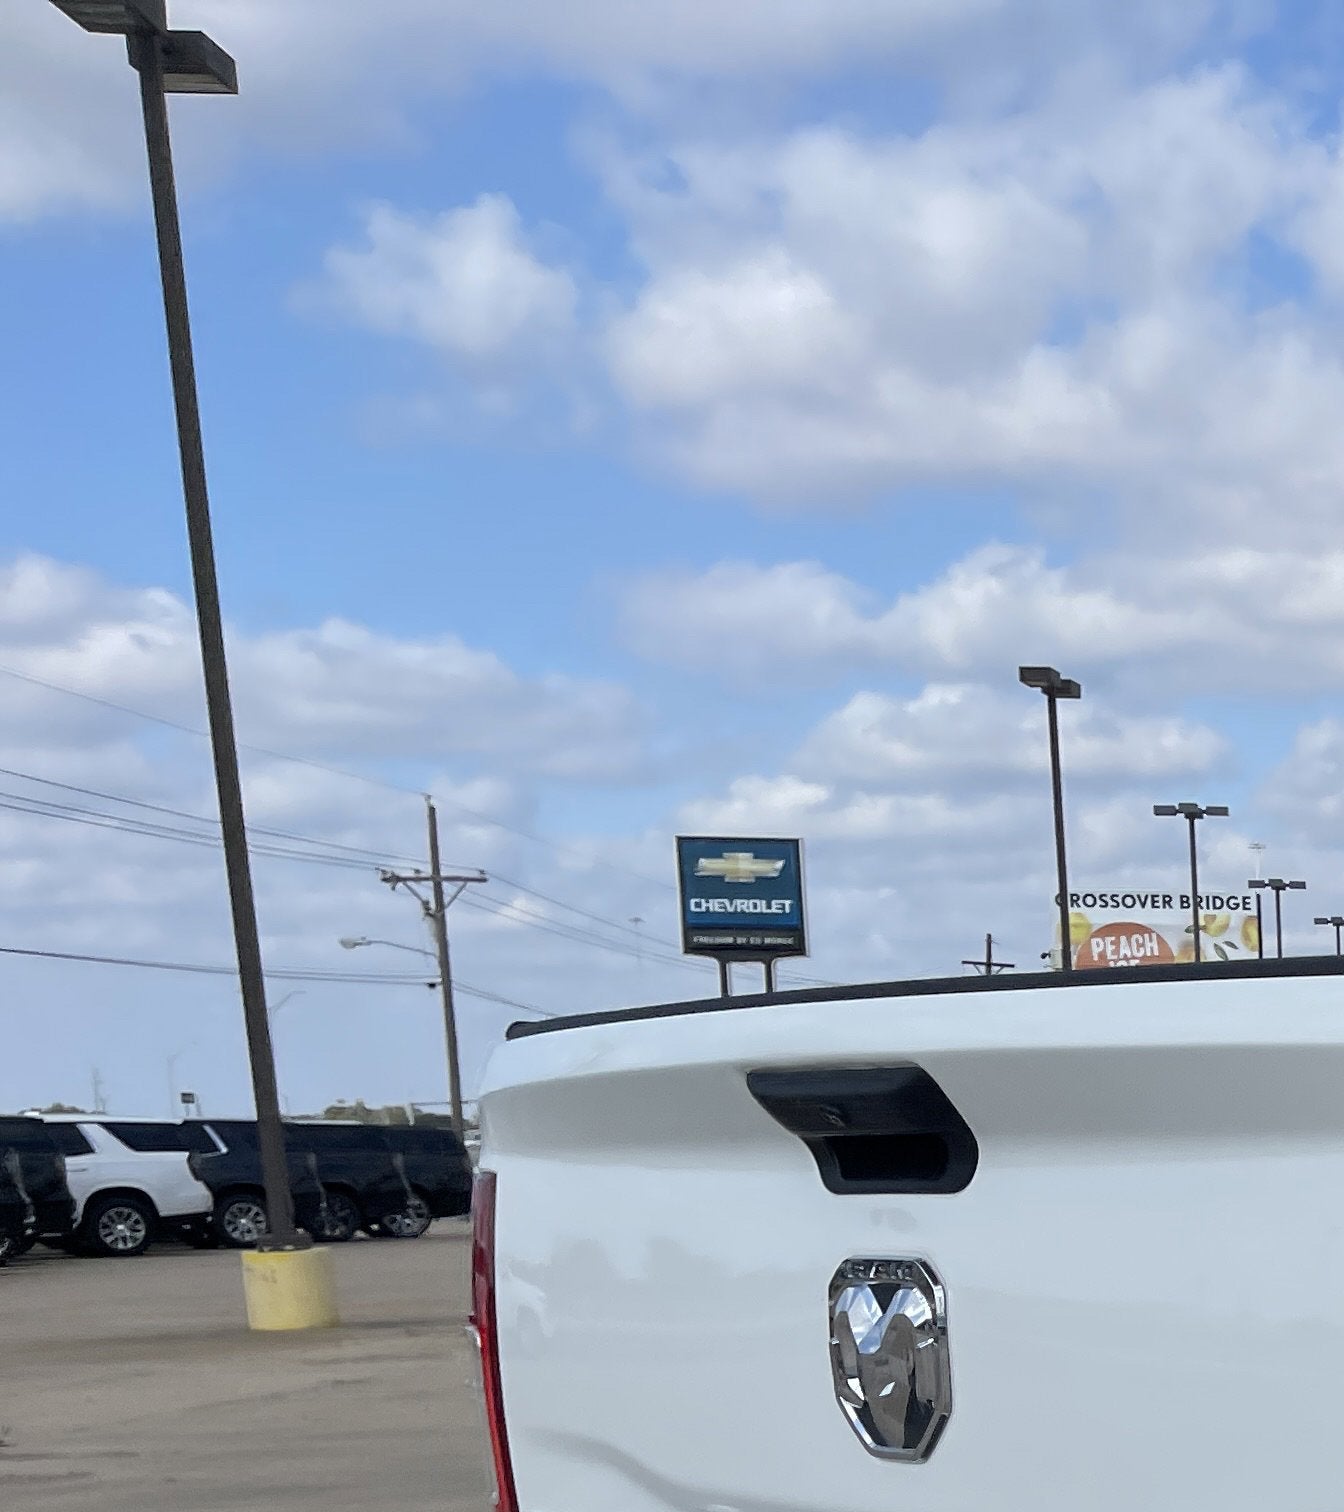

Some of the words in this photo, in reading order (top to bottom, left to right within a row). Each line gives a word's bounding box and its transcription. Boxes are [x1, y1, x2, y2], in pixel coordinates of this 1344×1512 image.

[689, 897, 793, 914] CHEVROLET
[1179, 894, 1252, 911] BRIDGE
[1090, 933, 1159, 961] PEACH
